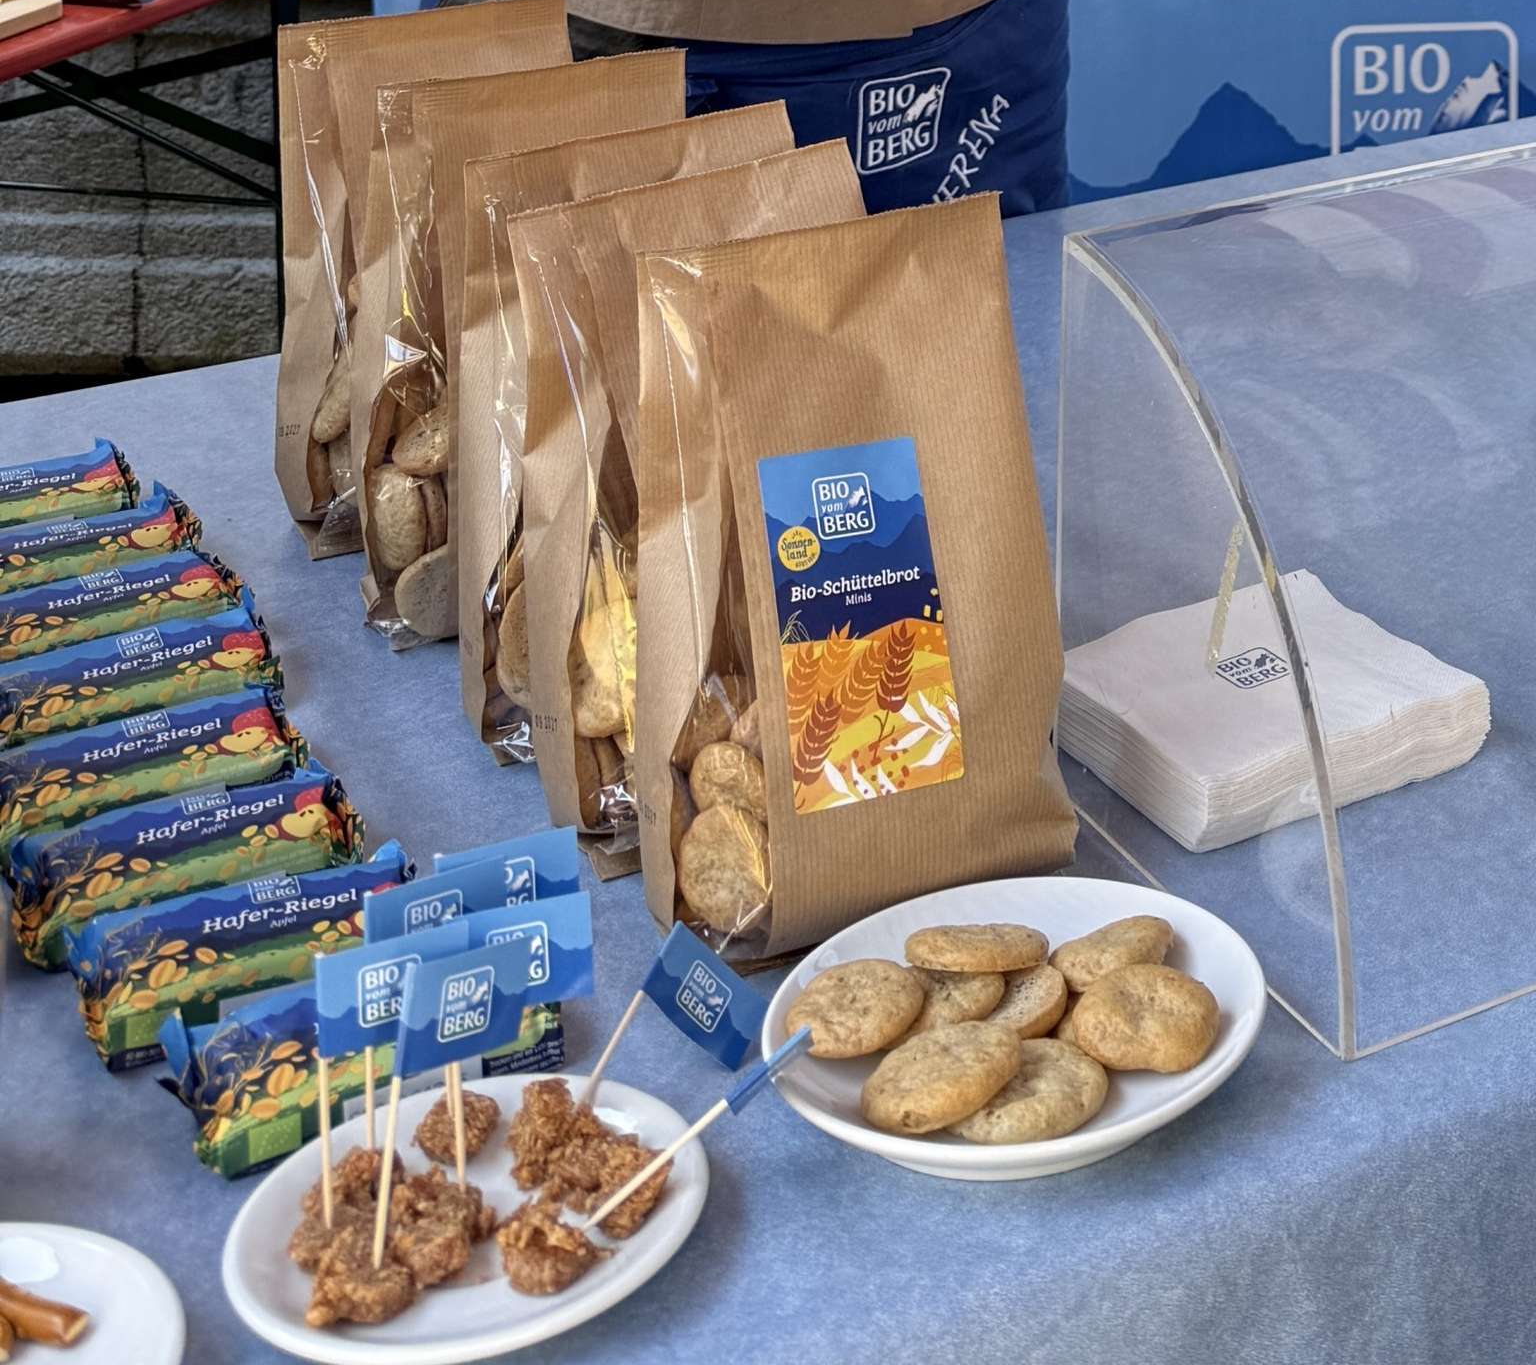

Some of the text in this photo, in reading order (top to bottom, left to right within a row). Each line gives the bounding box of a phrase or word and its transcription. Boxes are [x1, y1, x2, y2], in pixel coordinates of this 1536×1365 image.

[1354, 43, 1450, 96] BIO
[869, 83, 916, 117] BIO
[868, 114, 903, 136] vom
[1353, 107, 1423, 132] vom
[867, 121, 931, 167] BERG
[932, 94, 1010, 203] ERENA
[819, 481, 849, 501] BIO
[821, 502, 843, 513] vom
[823, 511, 869, 534] BERG
[13, 523, 132, 550] Hafer-Riegel
[48, 573, 171, 610] Hafer-Riegel
[790, 566, 921, 602] Bio-Schüttelbrot
[845, 592, 872, 606] Minis
[120, 633, 145, 645] BIO
[125, 640, 159, 657] BERG
[82, 636, 213, 680] Hafer-Riegel
[1217, 657, 1252, 673] BIO
[1236, 664, 1288, 686] BERG
[82, 718, 222, 763] Hafer-Riegel
[129, 721, 165, 736] BERG
[137, 794, 284, 845] Hafer-Riegel
[256, 886, 296, 902] BERG
[506, 893, 529, 908] RG
[202, 889, 358, 934] Hafer-Riegel
[270, 915, 297, 929] Apfel
[410, 900, 442, 925] BIO
[365, 963, 399, 990] BIO
[448, 977, 476, 999] BIO
[693, 965, 717, 994] BIO
[366, 987, 391, 1002] vom
[367, 996, 403, 1021] BER
[681, 988, 714, 1027] BERG
[443, 1010, 485, 1035] BERG
